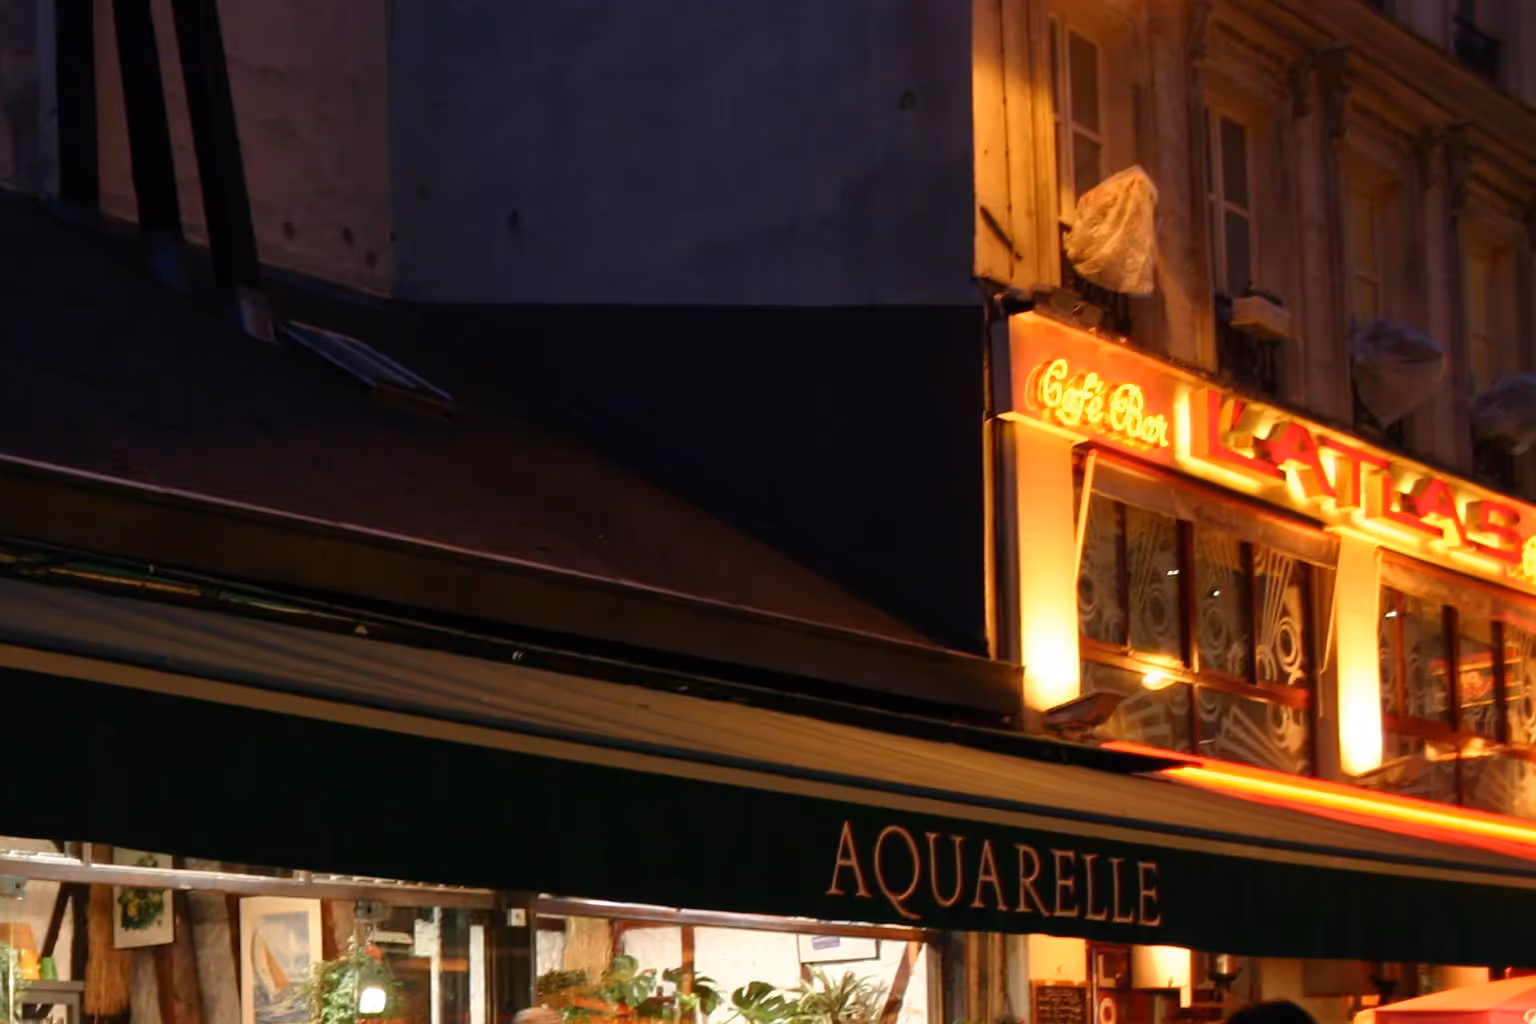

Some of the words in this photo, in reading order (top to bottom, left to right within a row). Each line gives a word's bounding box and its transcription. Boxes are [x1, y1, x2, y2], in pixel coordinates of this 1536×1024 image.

[1040, 358, 1105, 426] Café
[1108, 383, 1168, 447] Bar
[1191, 387, 1523, 566] L'ATLAS
[825, 819, 1161, 927] AQUARELLE
